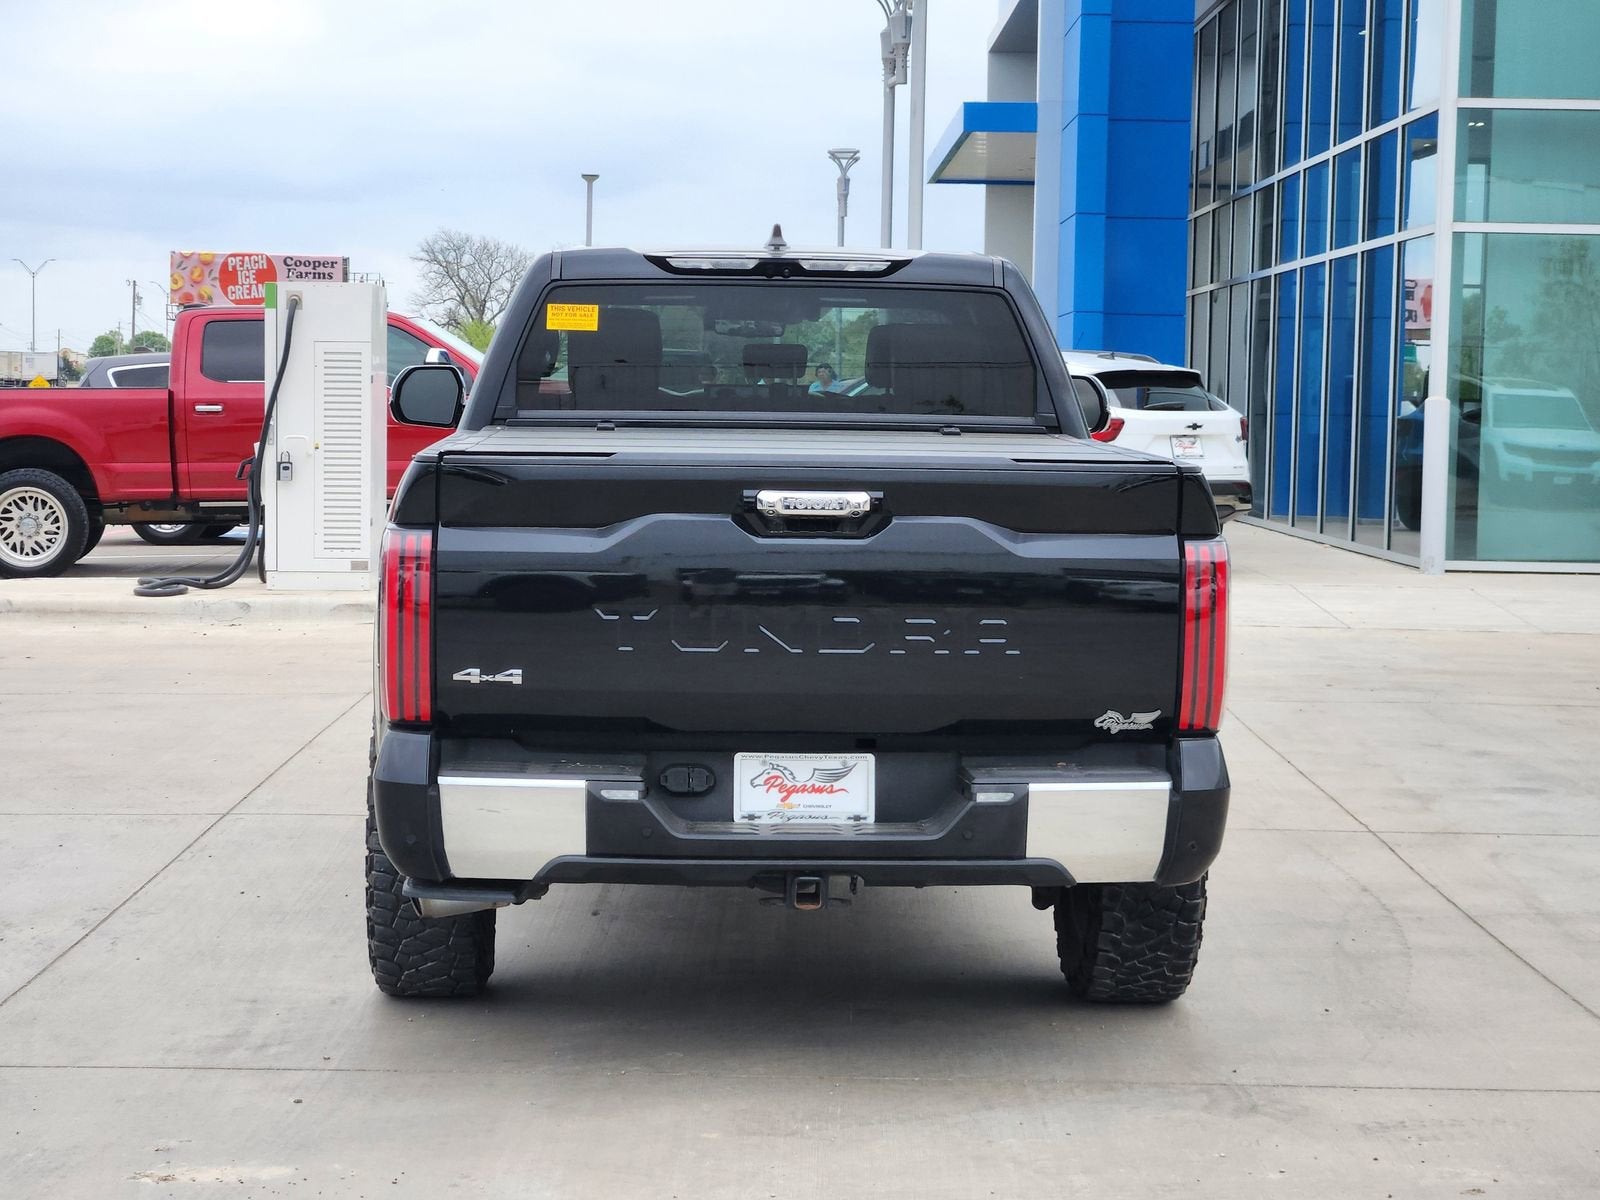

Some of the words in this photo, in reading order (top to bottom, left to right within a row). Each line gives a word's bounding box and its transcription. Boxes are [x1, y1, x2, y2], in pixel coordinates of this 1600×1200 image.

[228, 255, 267, 272] PEACH
[282, 256, 338, 270] Cooper
[237, 270, 257, 285] ICE
[286, 268, 334, 281] Farms
[566, 305, 596, 313] VEHICLE
[788, 498, 842, 509] TOYOTA
[763, 775, 850, 803] Pegasus
